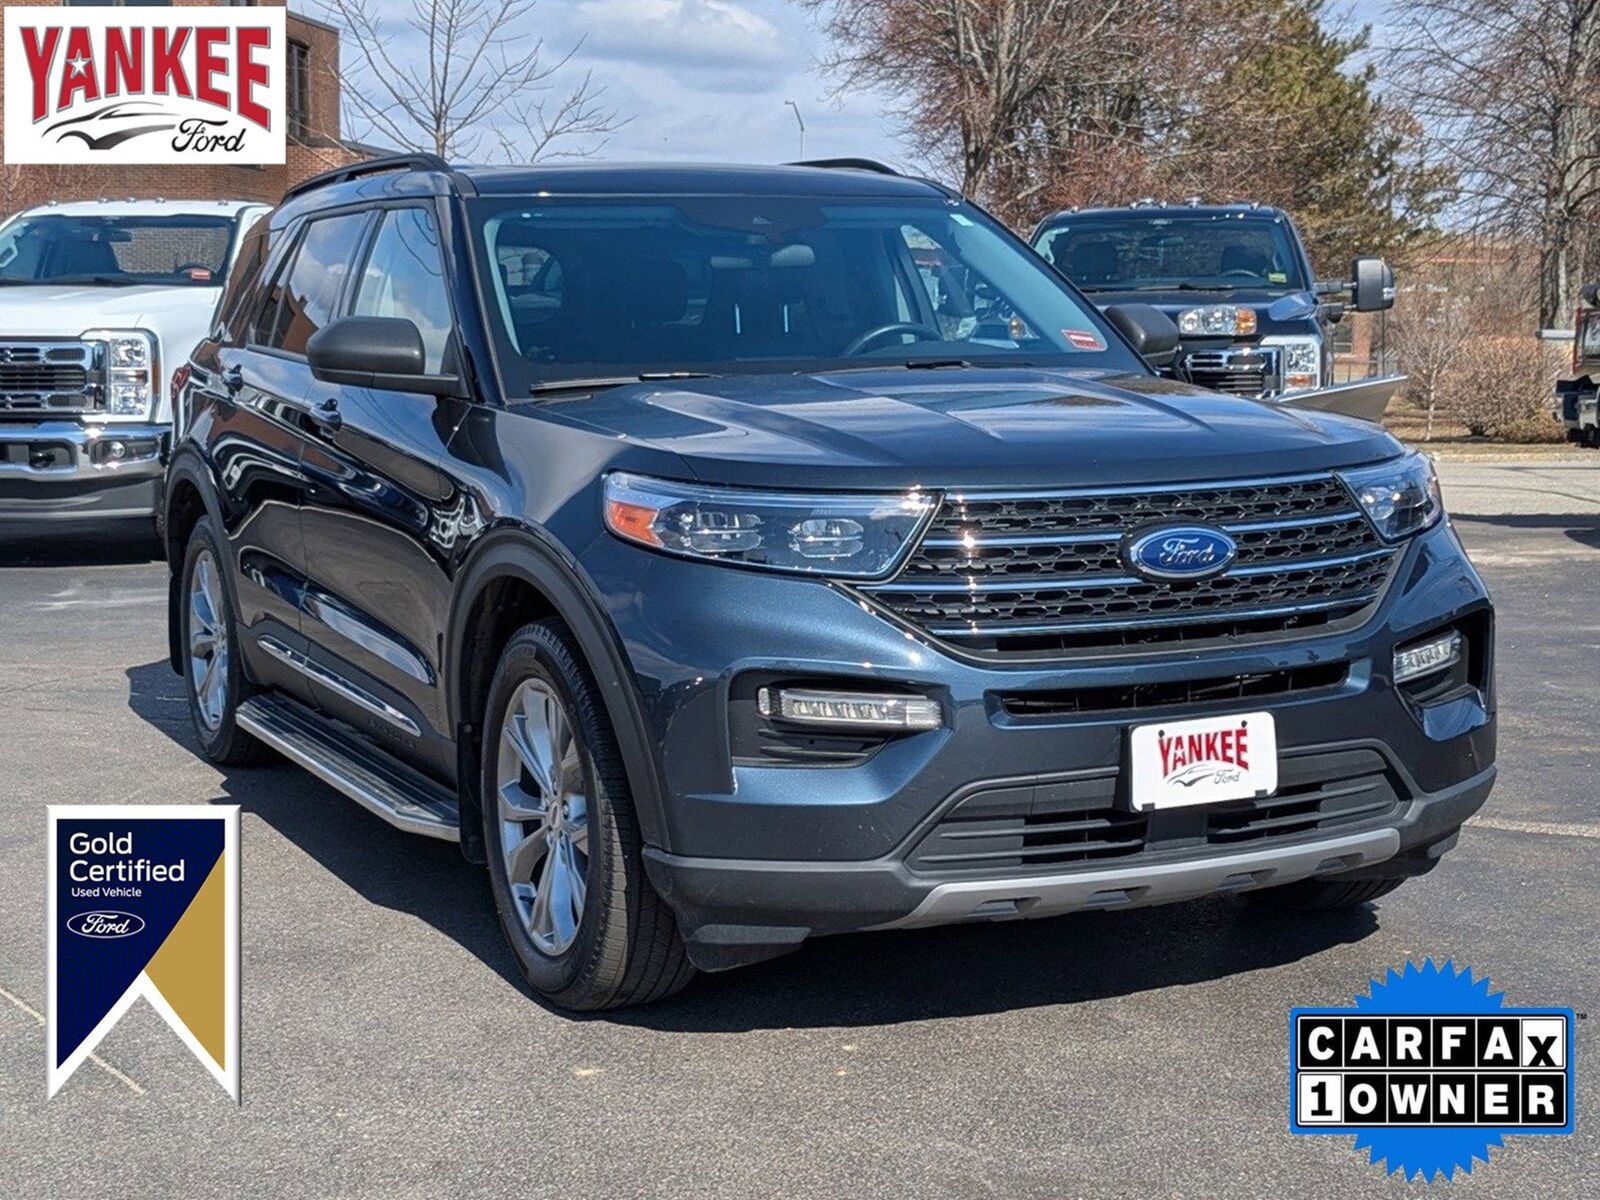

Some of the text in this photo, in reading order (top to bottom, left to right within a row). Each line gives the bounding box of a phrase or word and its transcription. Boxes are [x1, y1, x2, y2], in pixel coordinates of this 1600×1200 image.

[1159, 537, 1215, 566] Ford
[1158, 728, 1249, 778] YANKEE
[1213, 768, 1241, 785] Ford
